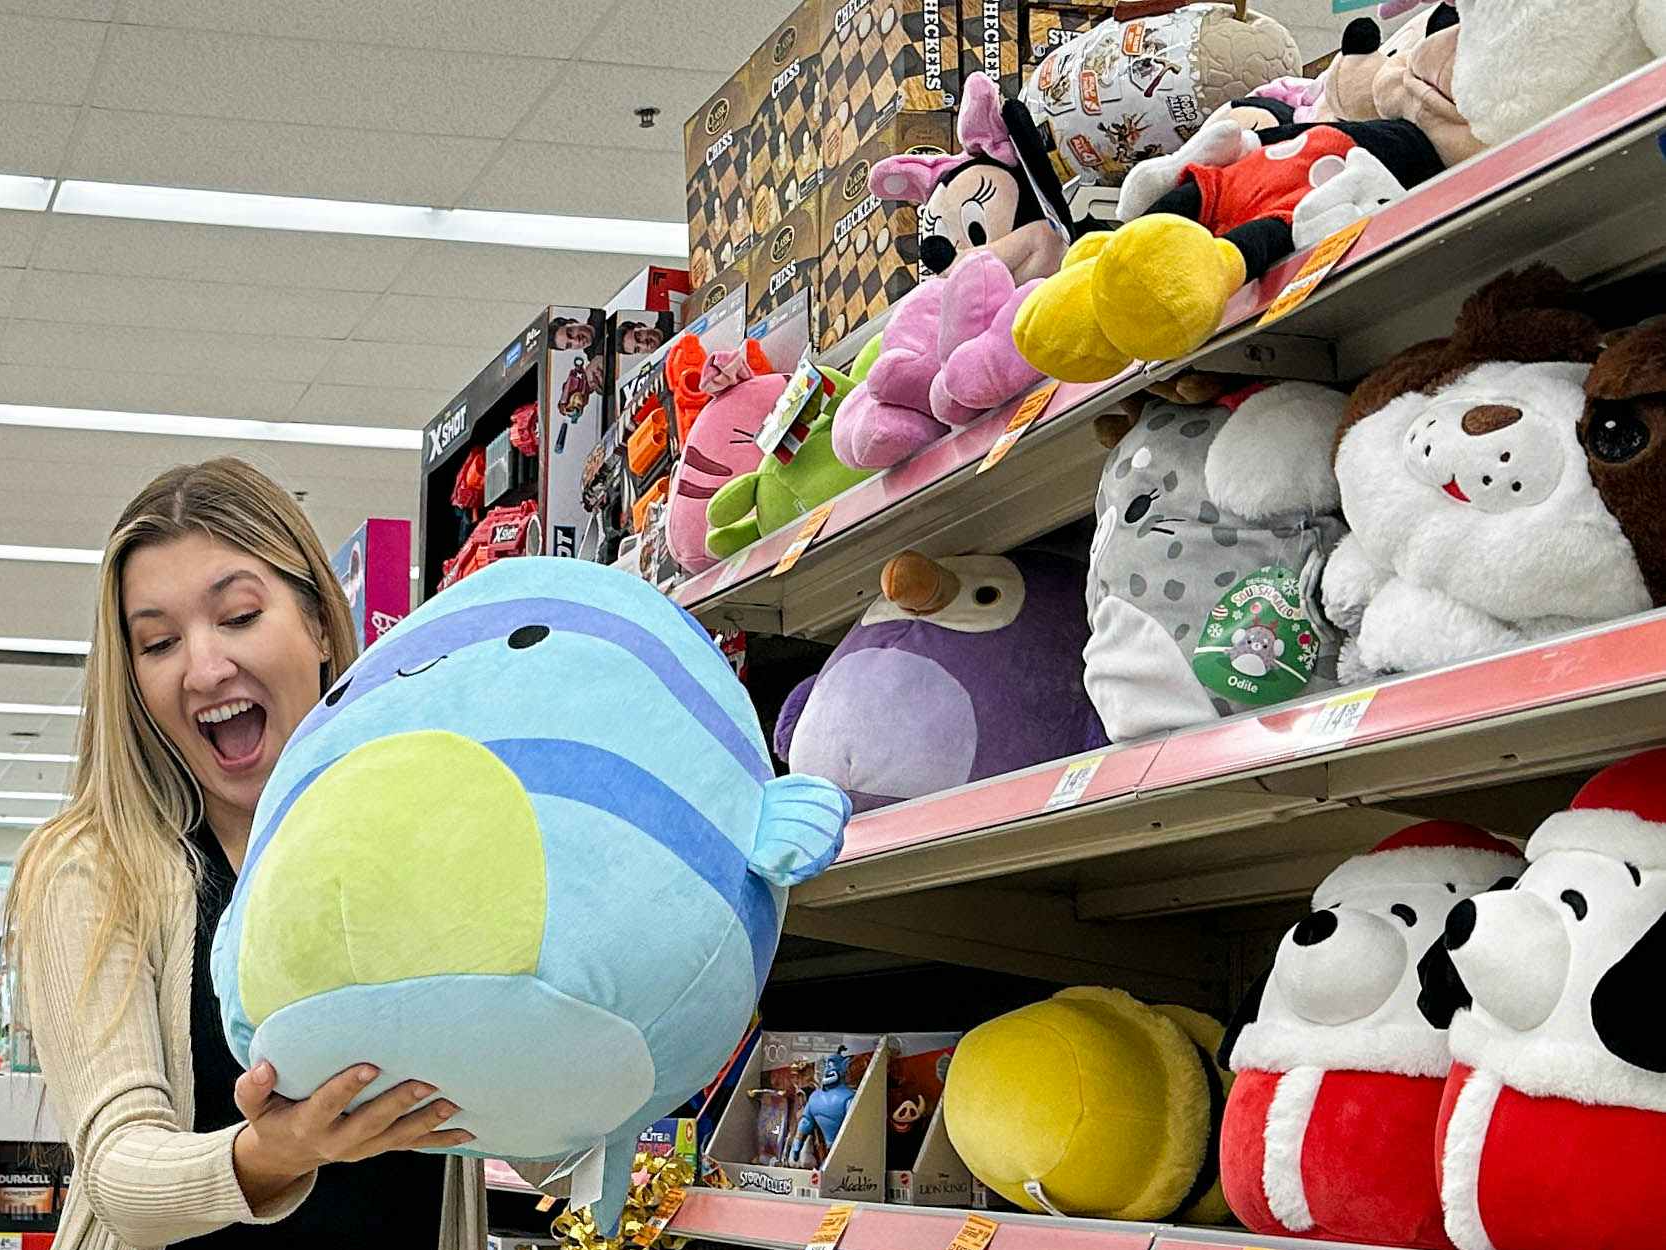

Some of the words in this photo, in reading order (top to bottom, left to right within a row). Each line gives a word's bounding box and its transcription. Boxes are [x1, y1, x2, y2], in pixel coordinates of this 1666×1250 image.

[923, 0, 941, 90] HECKERS
[1227, 676, 1258, 693] Odile
[830, 1175, 877, 1193] Aladdin
